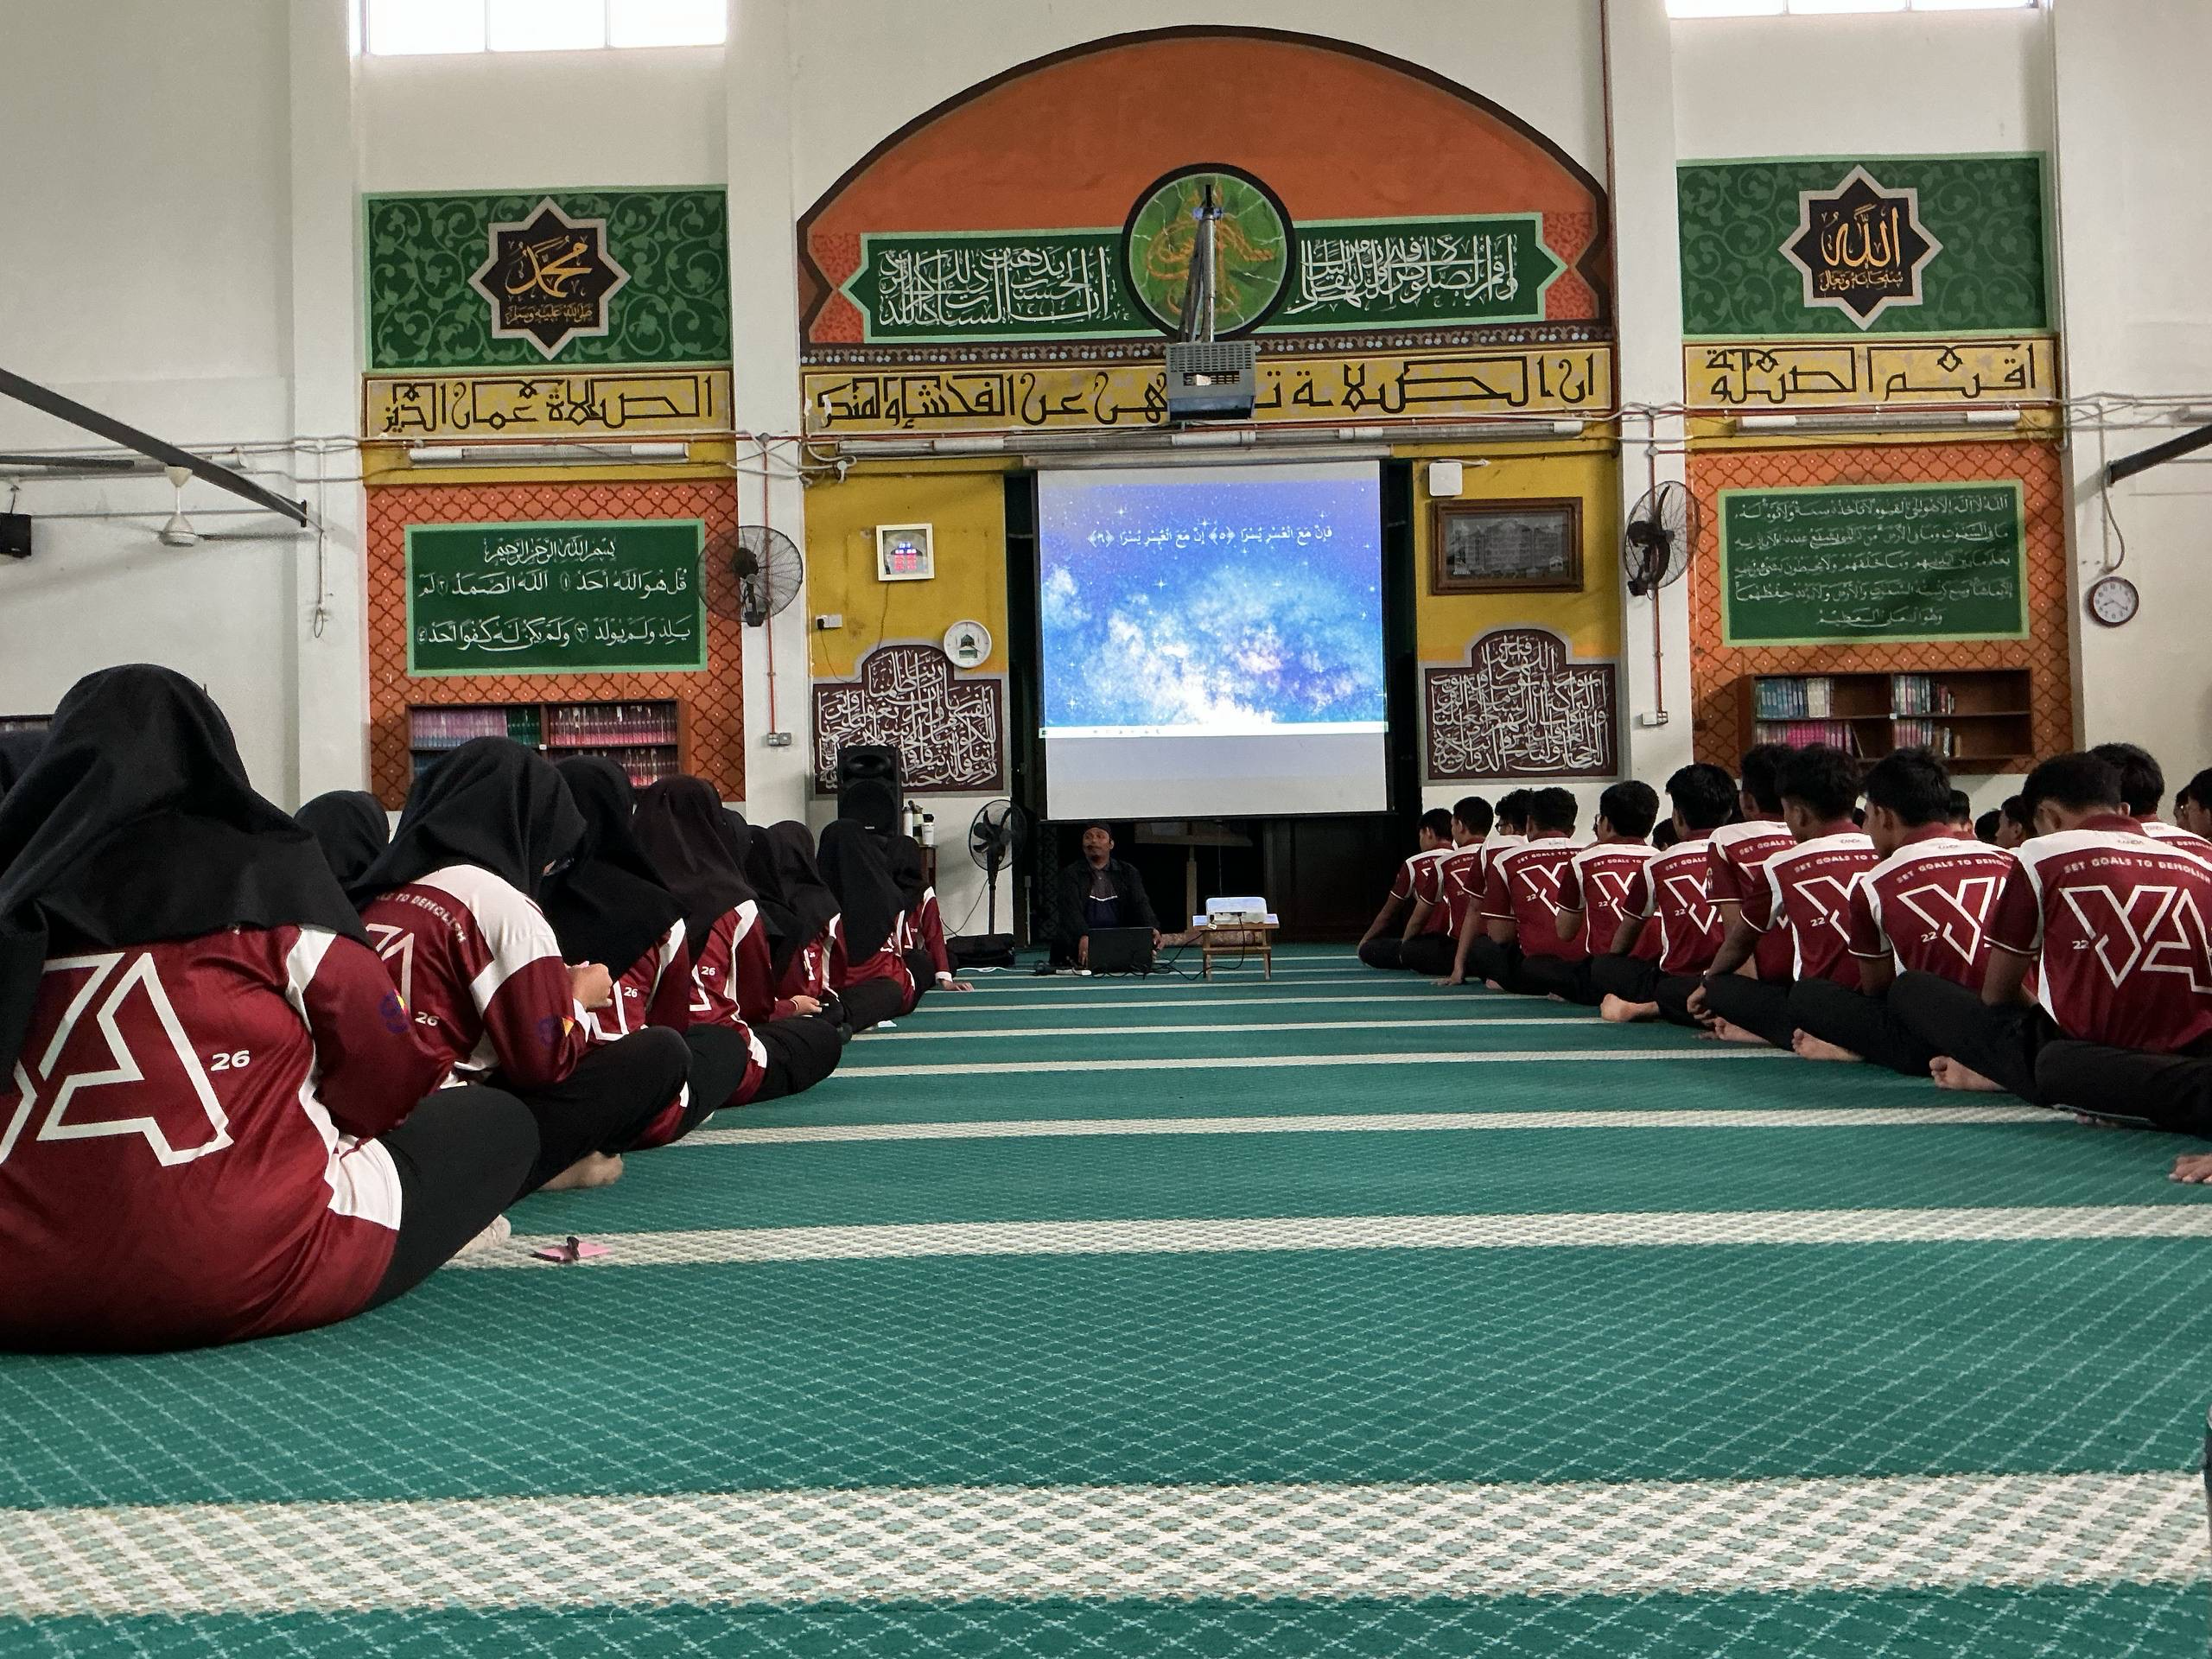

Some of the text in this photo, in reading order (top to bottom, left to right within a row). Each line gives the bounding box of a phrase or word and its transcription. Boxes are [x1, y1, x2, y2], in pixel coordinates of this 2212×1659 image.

[1821, 204, 1901, 268] الله
[505, 235, 594, 298] محمد
[1020, 372, 1090, 426] عن
[450, 571, 518, 595] الصمد
[518, 569, 550, 592] الله
[613, 569, 644, 591] الله
[639, 570, 668, 600] هو
[666, 568, 689, 595] قل
[1757, 840, 1786, 849] GOALS
[1815, 855, 1851, 865] GOALS
[2063, 856, 2212, 885] SET GOALS TO DEMOLISH
[1896, 869, 1914, 884] SET
[1917, 860, 1954, 873] GOALS
[1810, 917, 1826, 927] 22
[1921, 931, 1938, 943] 22
[2072, 940, 2088, 950] 22
[701, 966, 716, 977] 26
[623, 986, 639, 999] 26
[414, 1011, 439, 1027] 26
[210, 1049, 251, 1072] 26
